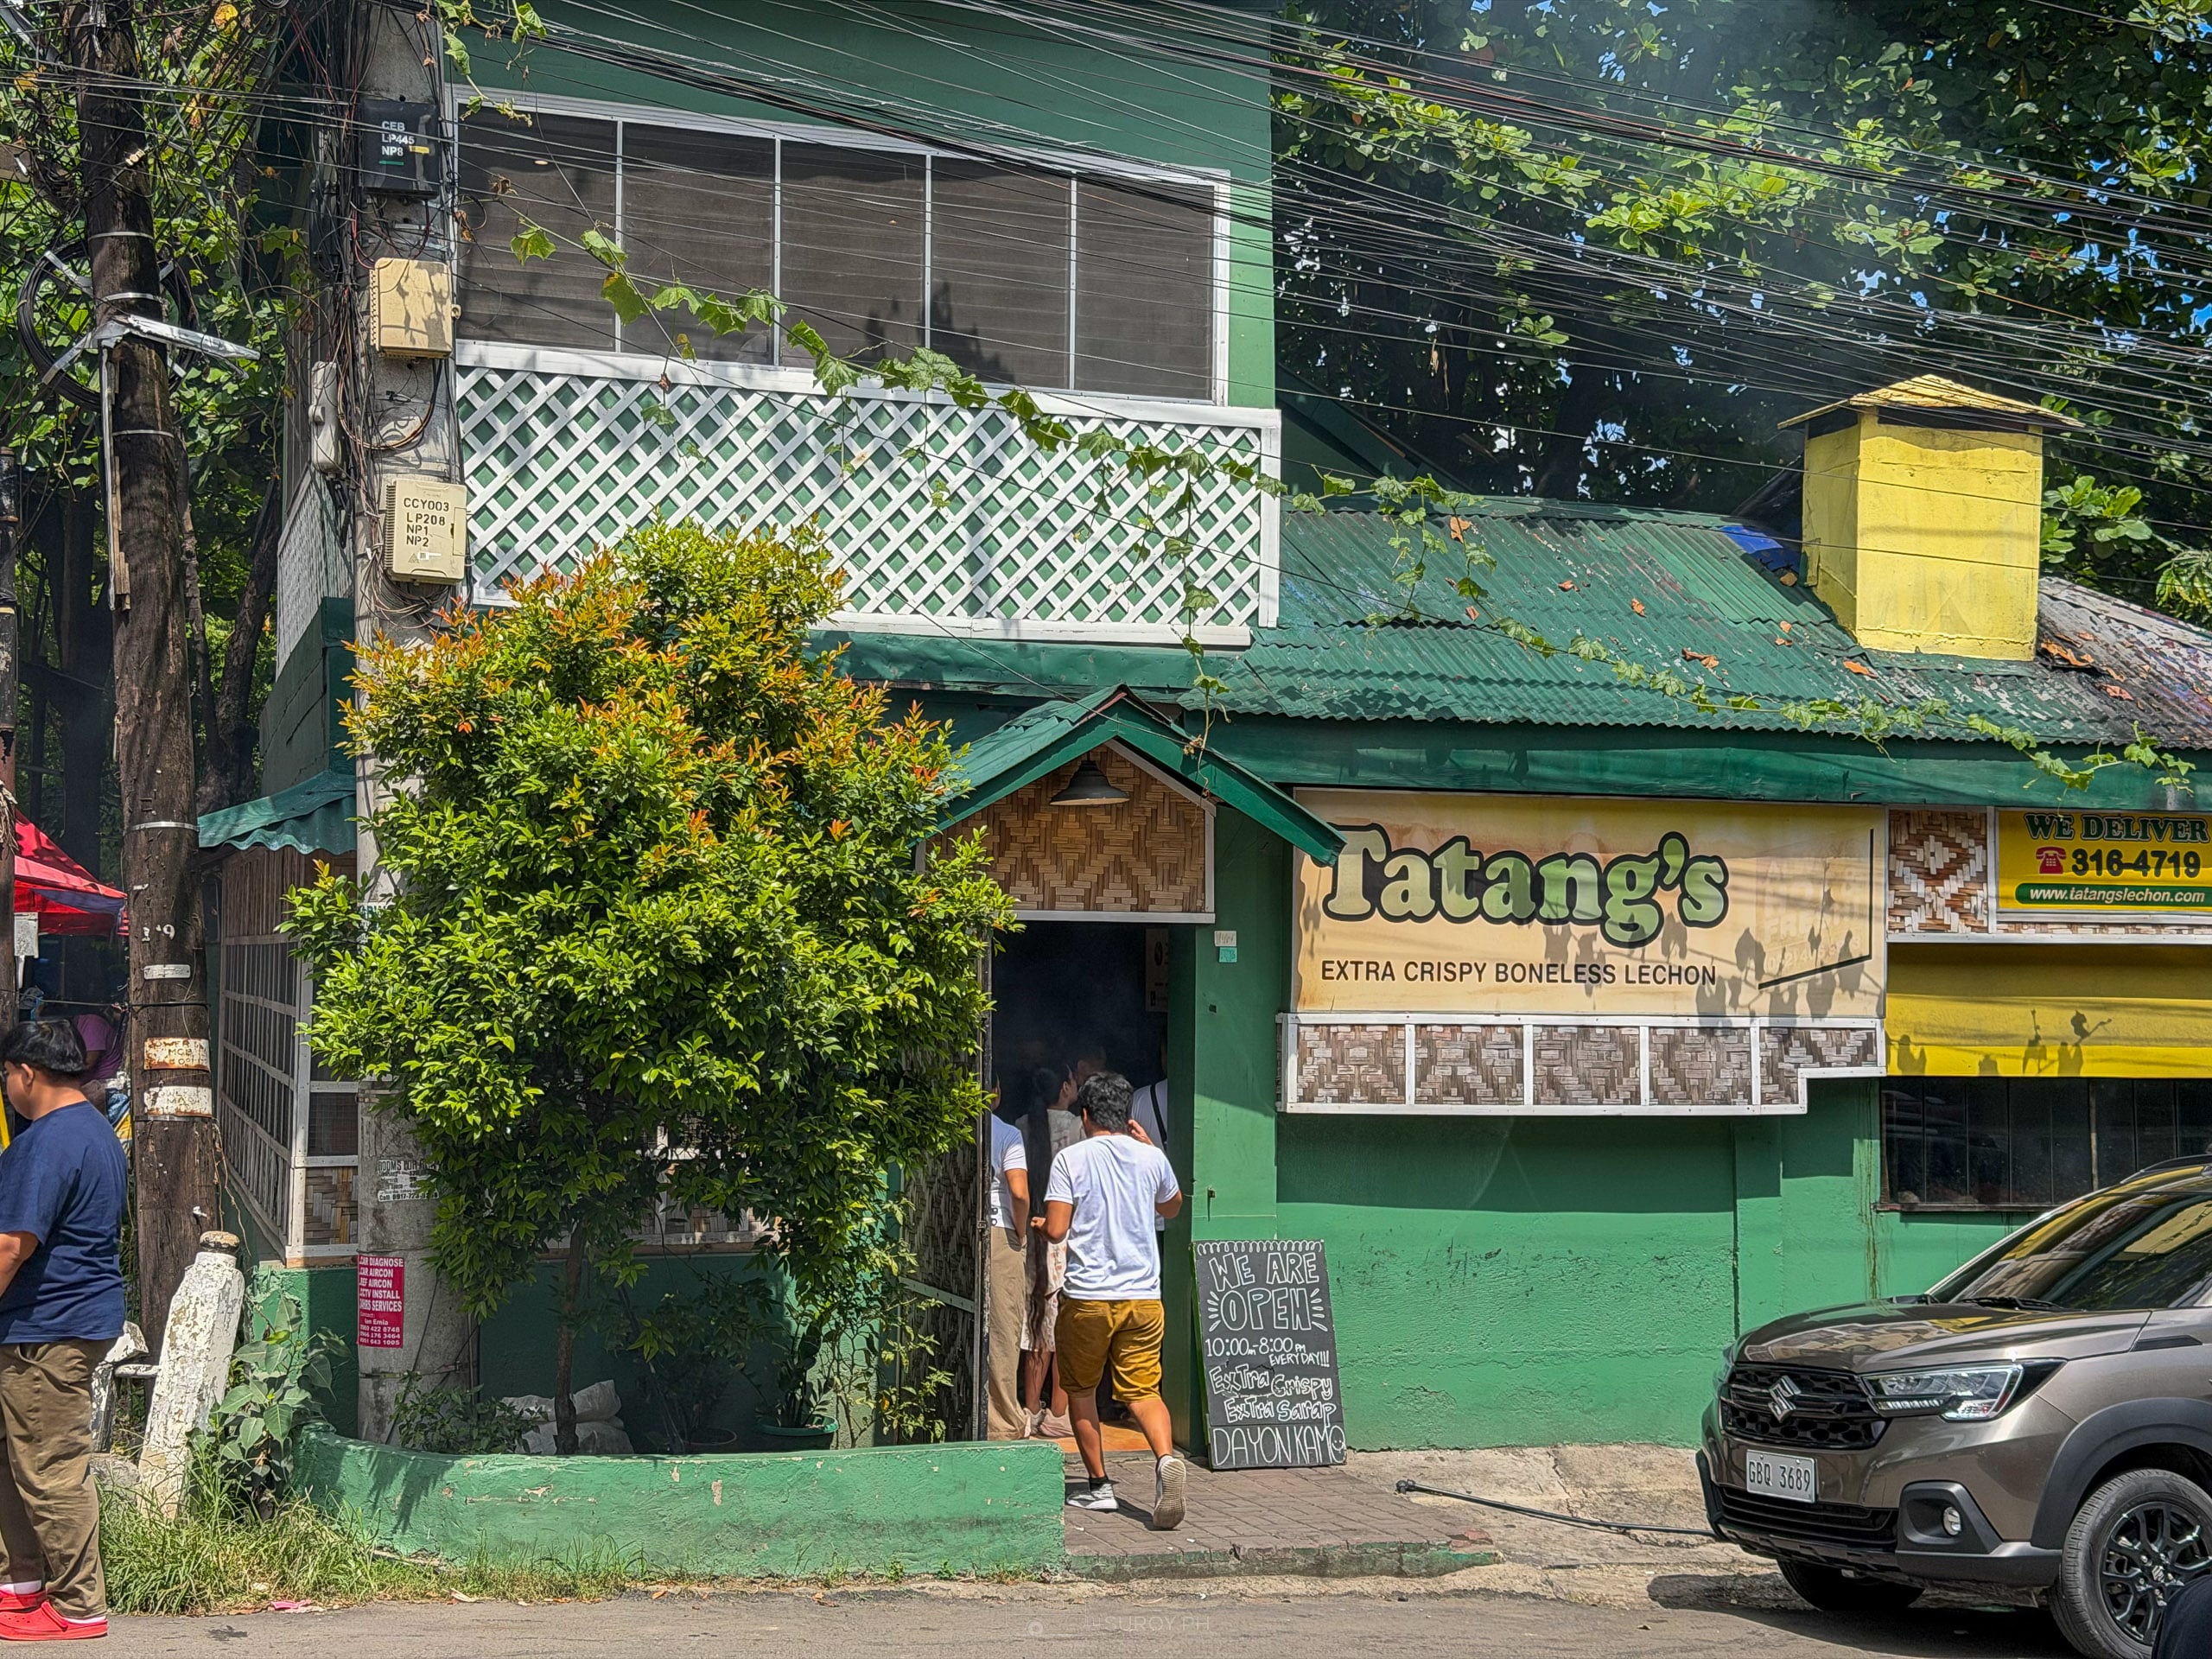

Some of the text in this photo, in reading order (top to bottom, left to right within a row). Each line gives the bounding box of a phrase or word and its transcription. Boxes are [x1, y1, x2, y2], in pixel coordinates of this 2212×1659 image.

[381, 120, 405, 131] CEB
[381, 133, 415, 144] LP445
[381, 145, 404, 156] NP8
[404, 497, 450, 512] CCY003
[406, 524, 429, 535] NP1
[406, 536, 429, 547] NP2
[2024, 813, 2210, 844] WE DELIVER
[2071, 849, 2201, 879] 316-4719
[1321, 823, 1730, 948] Tatang's
[2030, 887, 2206, 904] www.tatangslechon.com
[1320, 959, 1717, 986] EXTRA CRISPY BONELESS LECHON
[369, 1257, 404, 1267] DIAGNOSE
[369, 1268, 394, 1278] AIRCON
[1208, 1252, 1320, 1293] WE ARE
[368, 1279, 392, 1288] AIRCON
[372, 1289, 401, 1300] INSTALL
[372, 1300, 403, 1313] SERVICES
[1220, 1287, 1313, 1332] OPEN
[1212, 1427, 1293, 1466] DAYON
[1748, 1460, 1811, 1492] GBQ 3689
